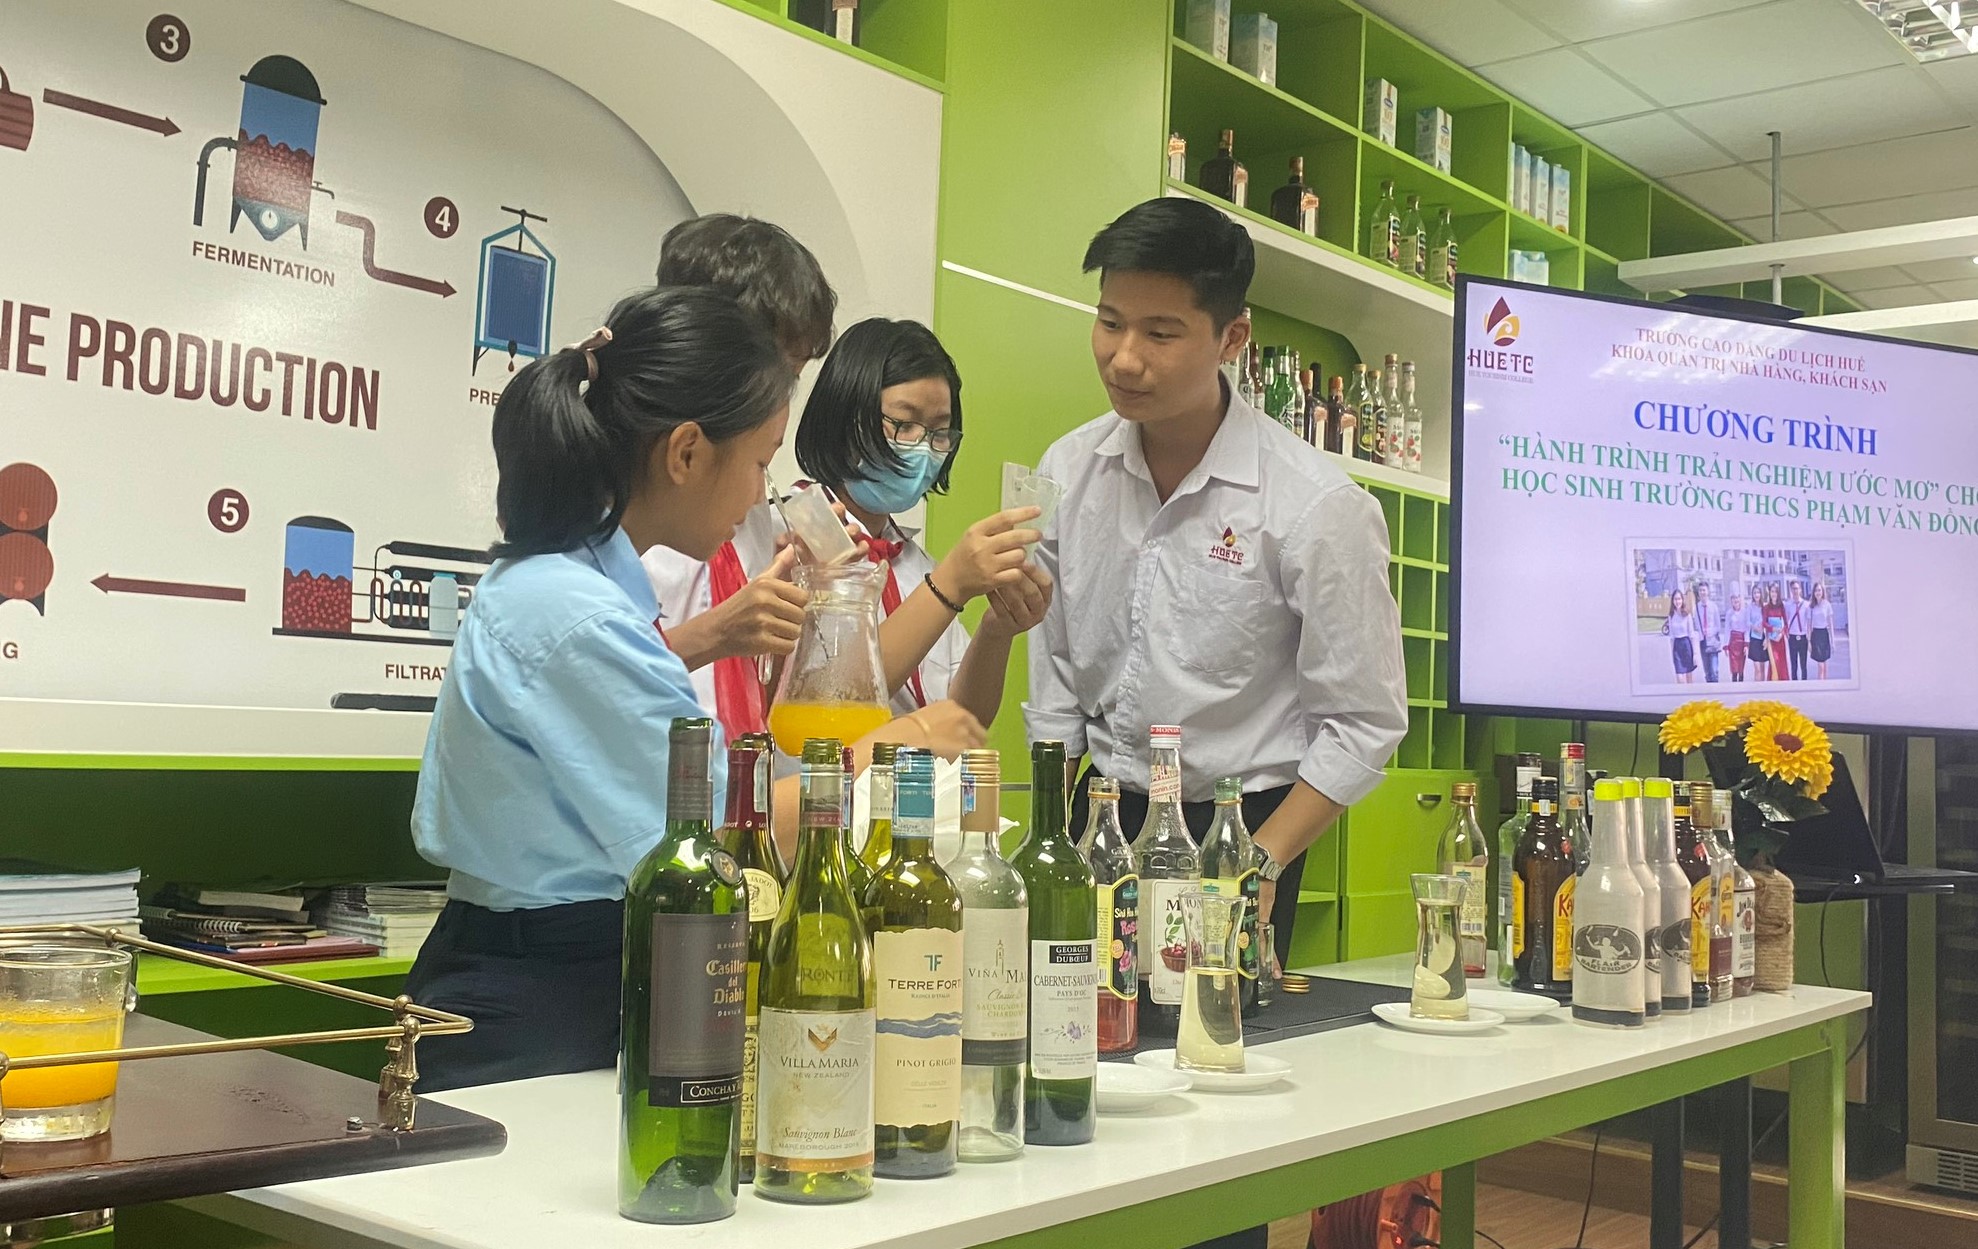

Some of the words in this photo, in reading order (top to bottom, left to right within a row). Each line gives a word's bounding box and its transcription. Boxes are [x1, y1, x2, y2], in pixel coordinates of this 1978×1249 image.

[160, 25, 180, 54] 3
[434, 206, 452, 231] 4
[192, 240, 335, 287] FERMENTATION
[1467, 348, 1534, 374] HUETC
[1701, 337, 1732, 353] CAO
[1779, 348, 1798, 363] DU
[1801, 351, 1834, 369] LỊCH
[66, 311, 380, 431] PRODUCTION
[1611, 343, 1654, 362] KHOA
[1810, 370, 1858, 390] KHÁCH
[1861, 377, 1887, 395] SẠN
[469, 388, 501, 407] PRE
[1634, 400, 1775, 444] CHƯƠNG
[1783, 414, 1879, 456] TRÌNH
[1592, 441, 1670, 474] TRÌNH
[1675, 452, 1733, 480] TRẢI
[1739, 460, 1832, 494] NGHIỆM
[1839, 468, 1888, 497] ƯỚC
[1945, 484, 1978, 507] CH
[1501, 467, 1559, 498] HỌC
[1564, 473, 1625, 501] SINH
[1630, 480, 1734, 512] TRƯỜNG
[1739, 492, 1800, 519] THCS
[1806, 499, 1871, 529] PHẠM
[1877, 503, 1922, 531] VĂN
[220, 496, 240, 525] 5
[2, 641, 19, 659] G
[1120, 920, 1137, 936] Ros
[1055, 946, 1089, 954] GEORGES
[1580, 958, 1632, 971] BARTENDER
[1591, 958, 1620, 967] FLAIR
[968, 967, 998, 978] VIÑA
[888, 978, 935, 990] TERRE
[936, 978, 962, 990] FORT
[780, 1055, 816, 1069] VILLA
[818, 1056, 860, 1069] MARIA
[896, 1059, 926, 1068] PINOT
[813, 1071, 851, 1079] ZEALAND
[689, 1084, 732, 1098] CONCHA
[782, 1127, 830, 1142] Sauvignon
